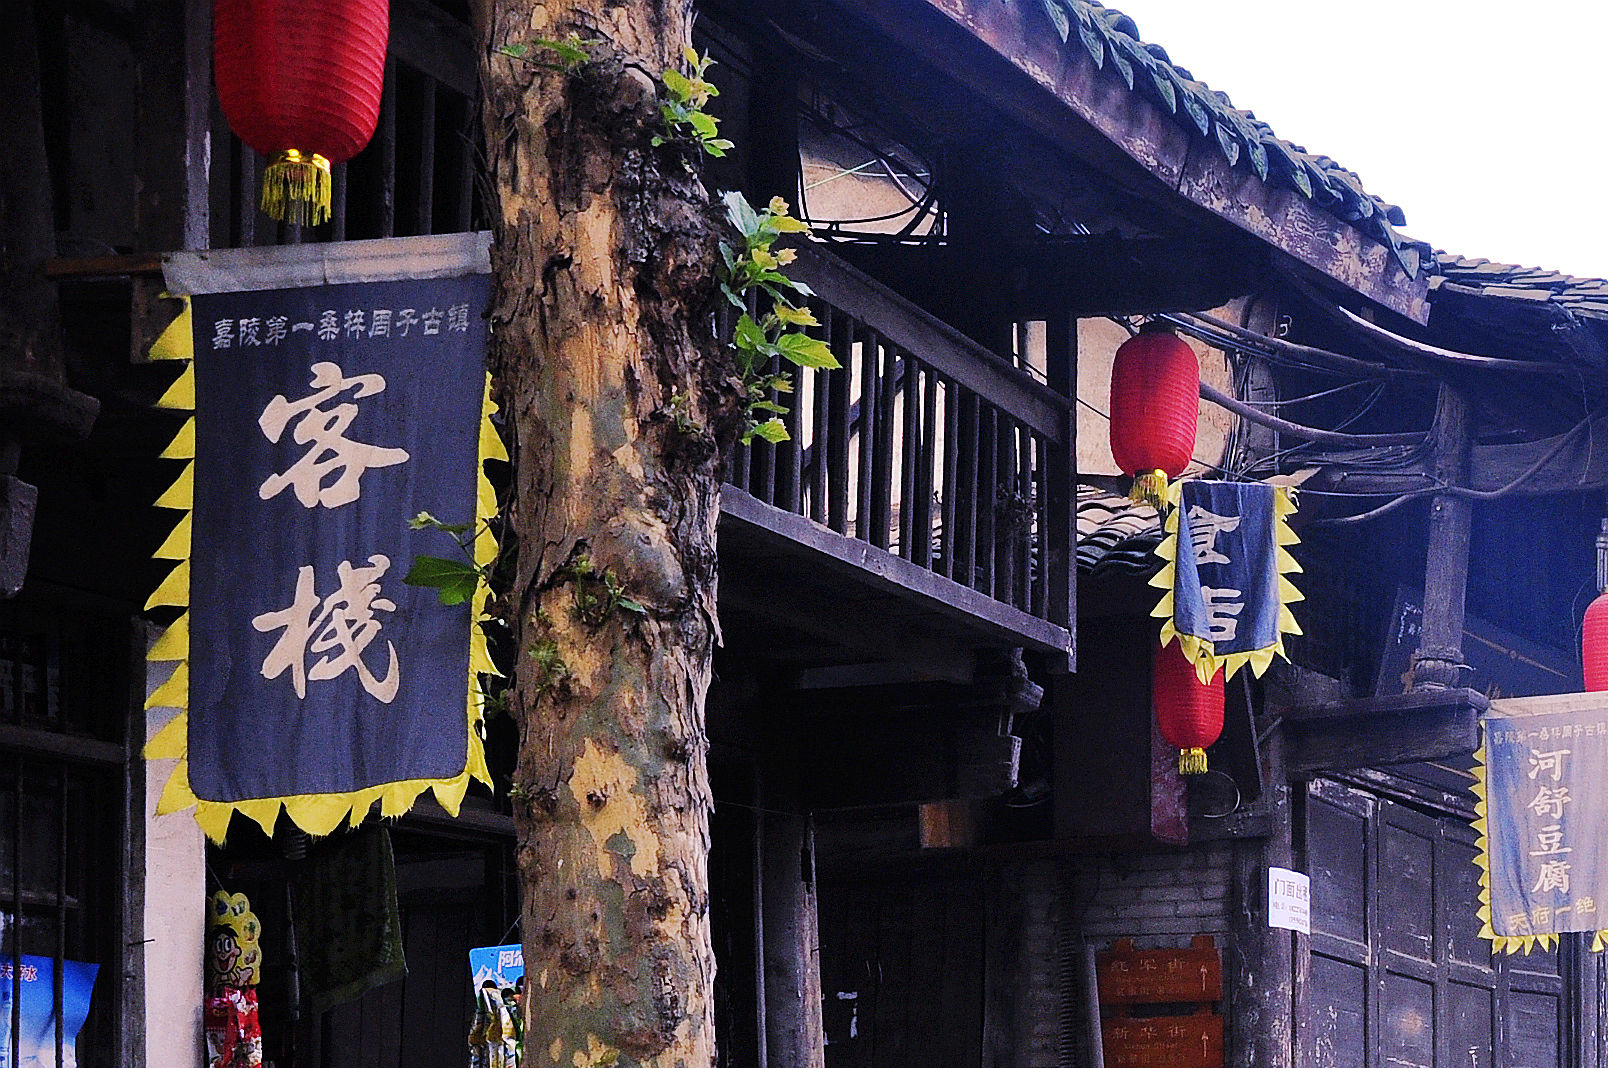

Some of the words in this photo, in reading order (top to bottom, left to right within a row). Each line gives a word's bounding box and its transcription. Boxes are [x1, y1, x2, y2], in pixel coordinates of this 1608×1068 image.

[1528, 748, 1573, 894] 河舒豆腐
[1509, 897, 1597, 931] 天府一绝
